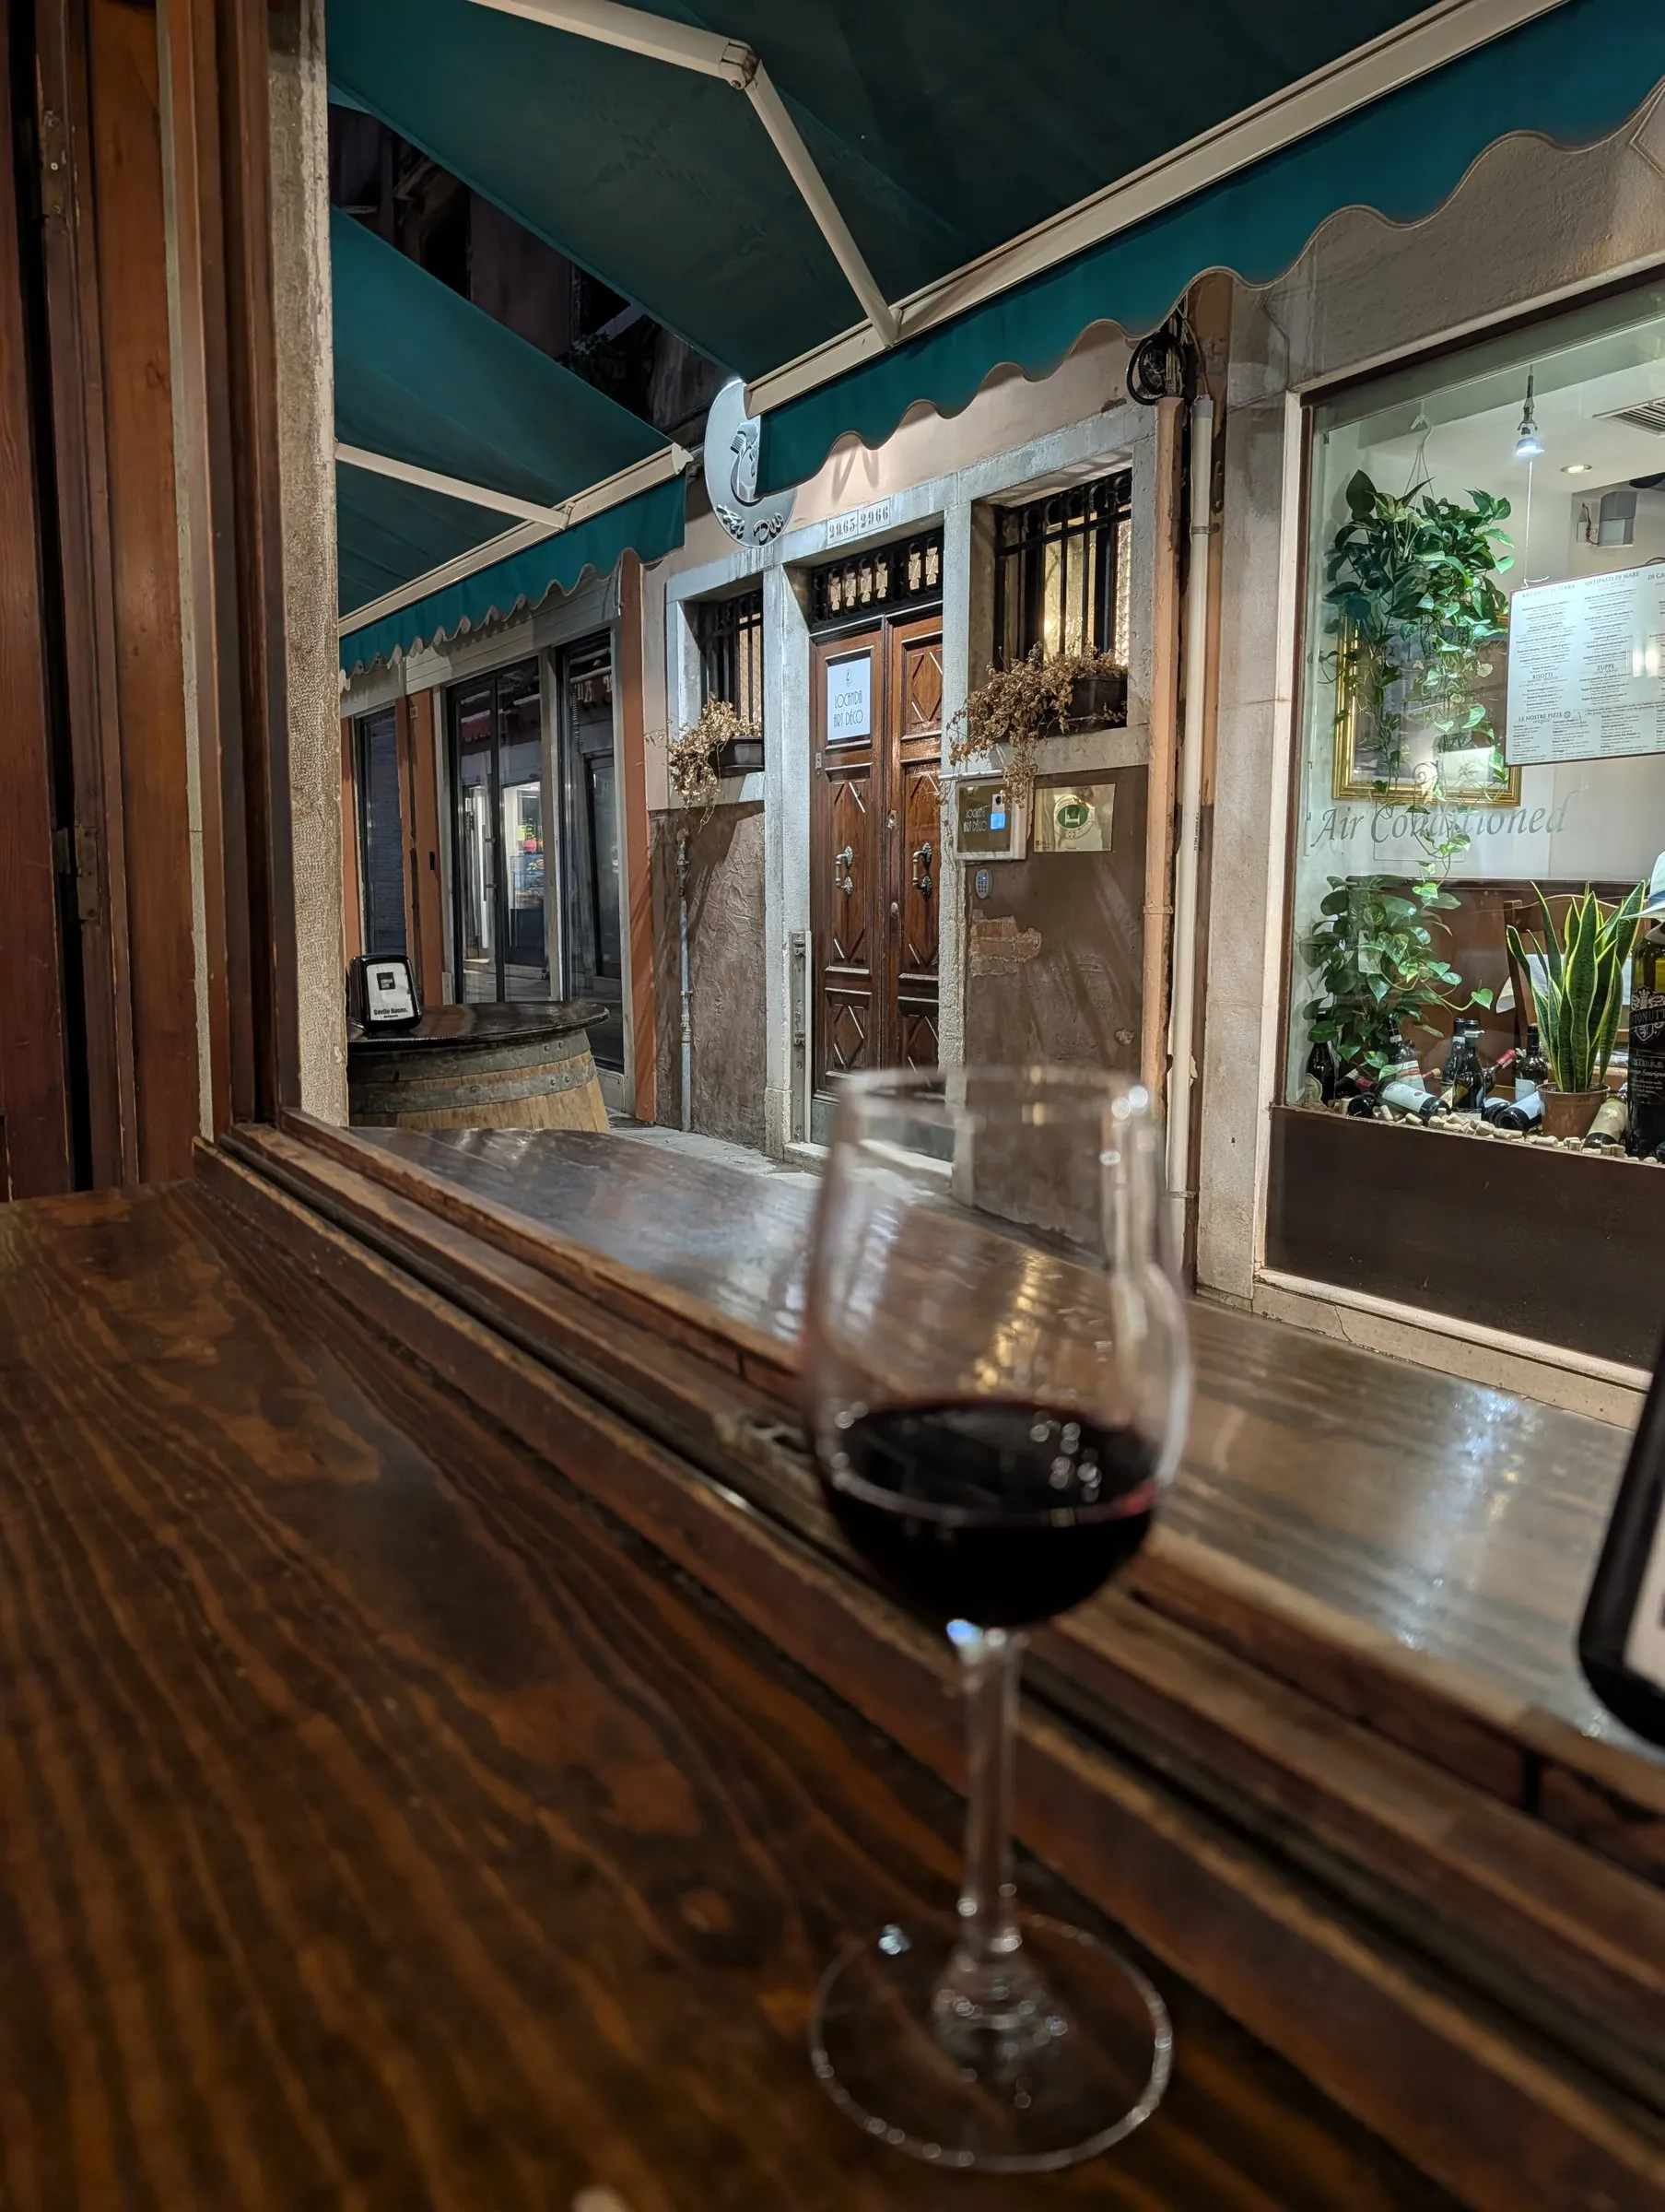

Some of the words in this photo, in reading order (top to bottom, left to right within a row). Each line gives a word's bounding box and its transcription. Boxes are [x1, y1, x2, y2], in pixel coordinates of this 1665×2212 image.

[829, 517, 856, 538] 2965
[861, 506, 888, 529] 2966
[1585, 576, 1614, 586] ANTIPASTI
[1532, 672, 1554, 680] RISOTTI
[834, 689, 862, 709] LOCANDA
[833, 712, 844, 728] ART
[845, 708, 863, 726] DÉCO
[1311, 806, 1364, 847] Air
[1371, 785, 1589, 843] Conditioned
